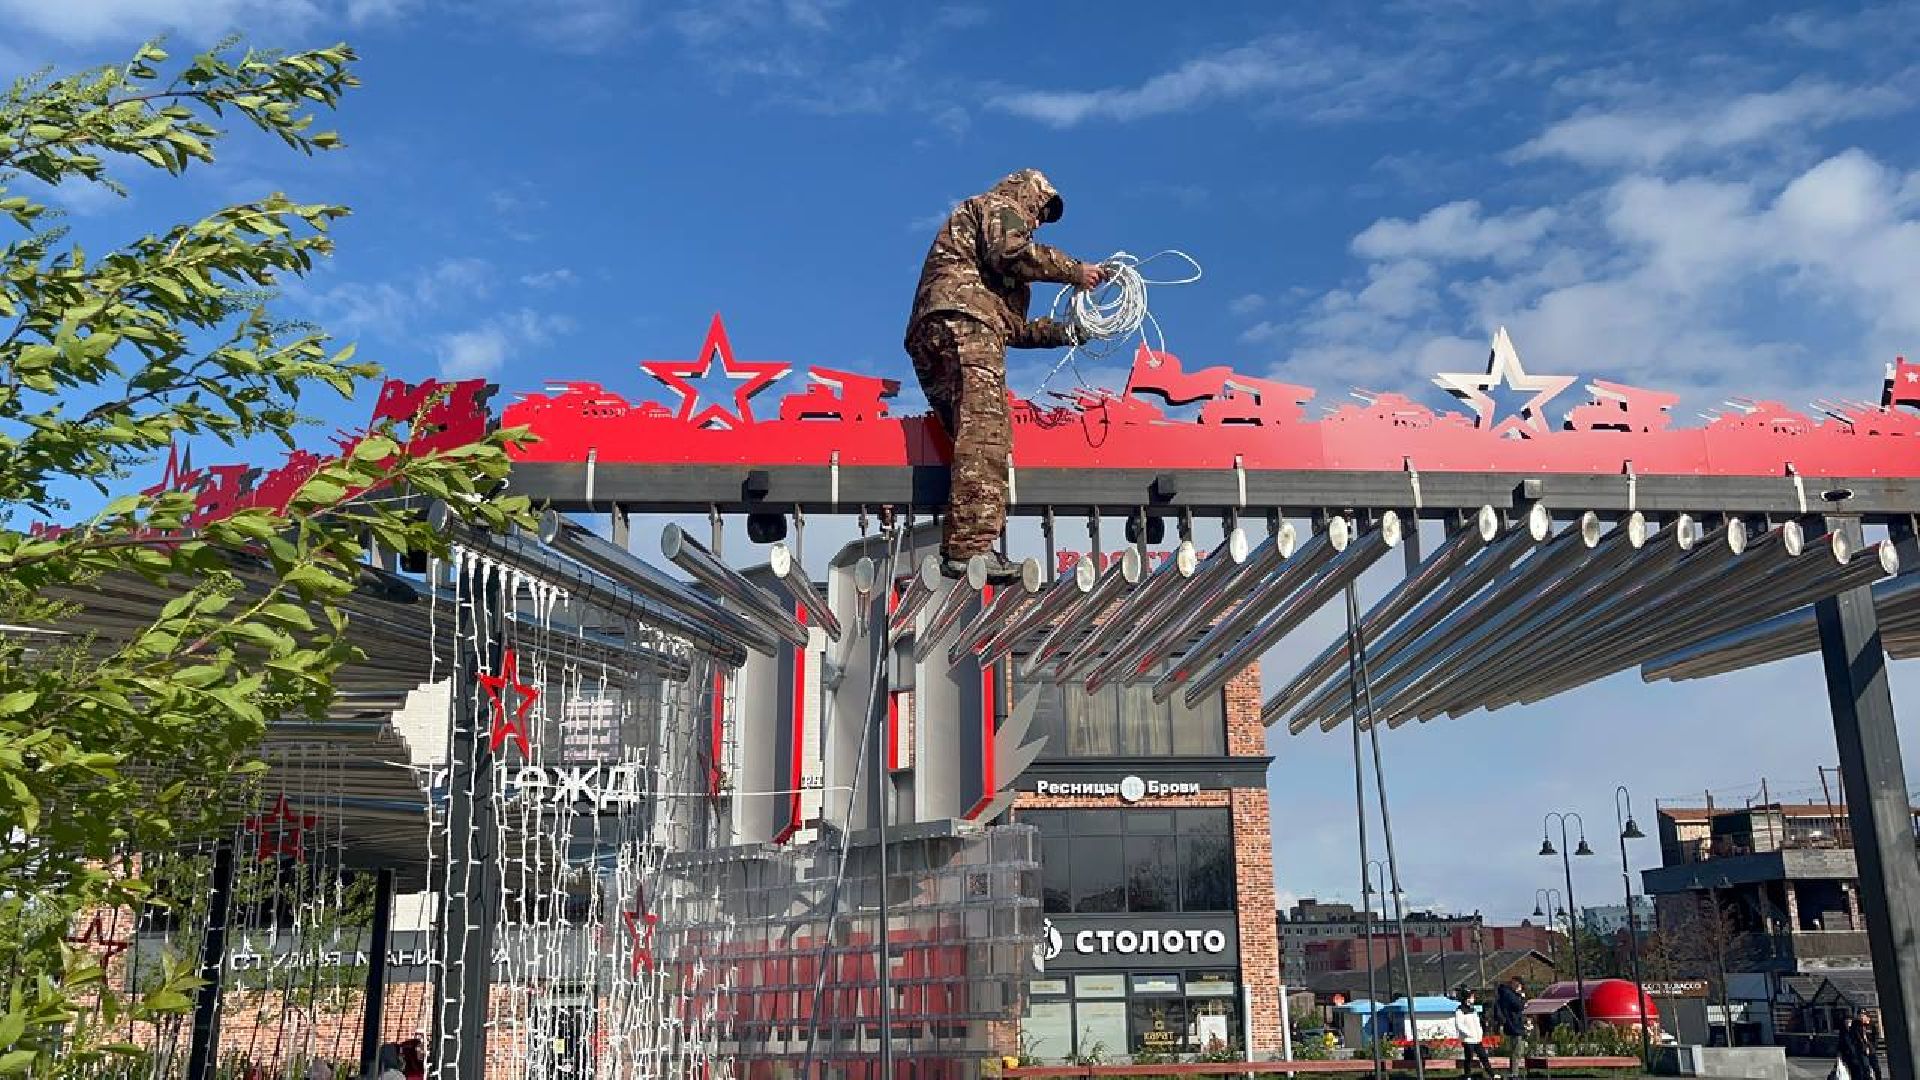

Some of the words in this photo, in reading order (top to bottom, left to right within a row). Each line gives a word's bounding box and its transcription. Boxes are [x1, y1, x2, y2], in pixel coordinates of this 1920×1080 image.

[1037, 780, 1120, 796] Ресницы
[1148, 780, 1199, 796] Брови
[1076, 930, 1226, 953] СТОЛОТО
